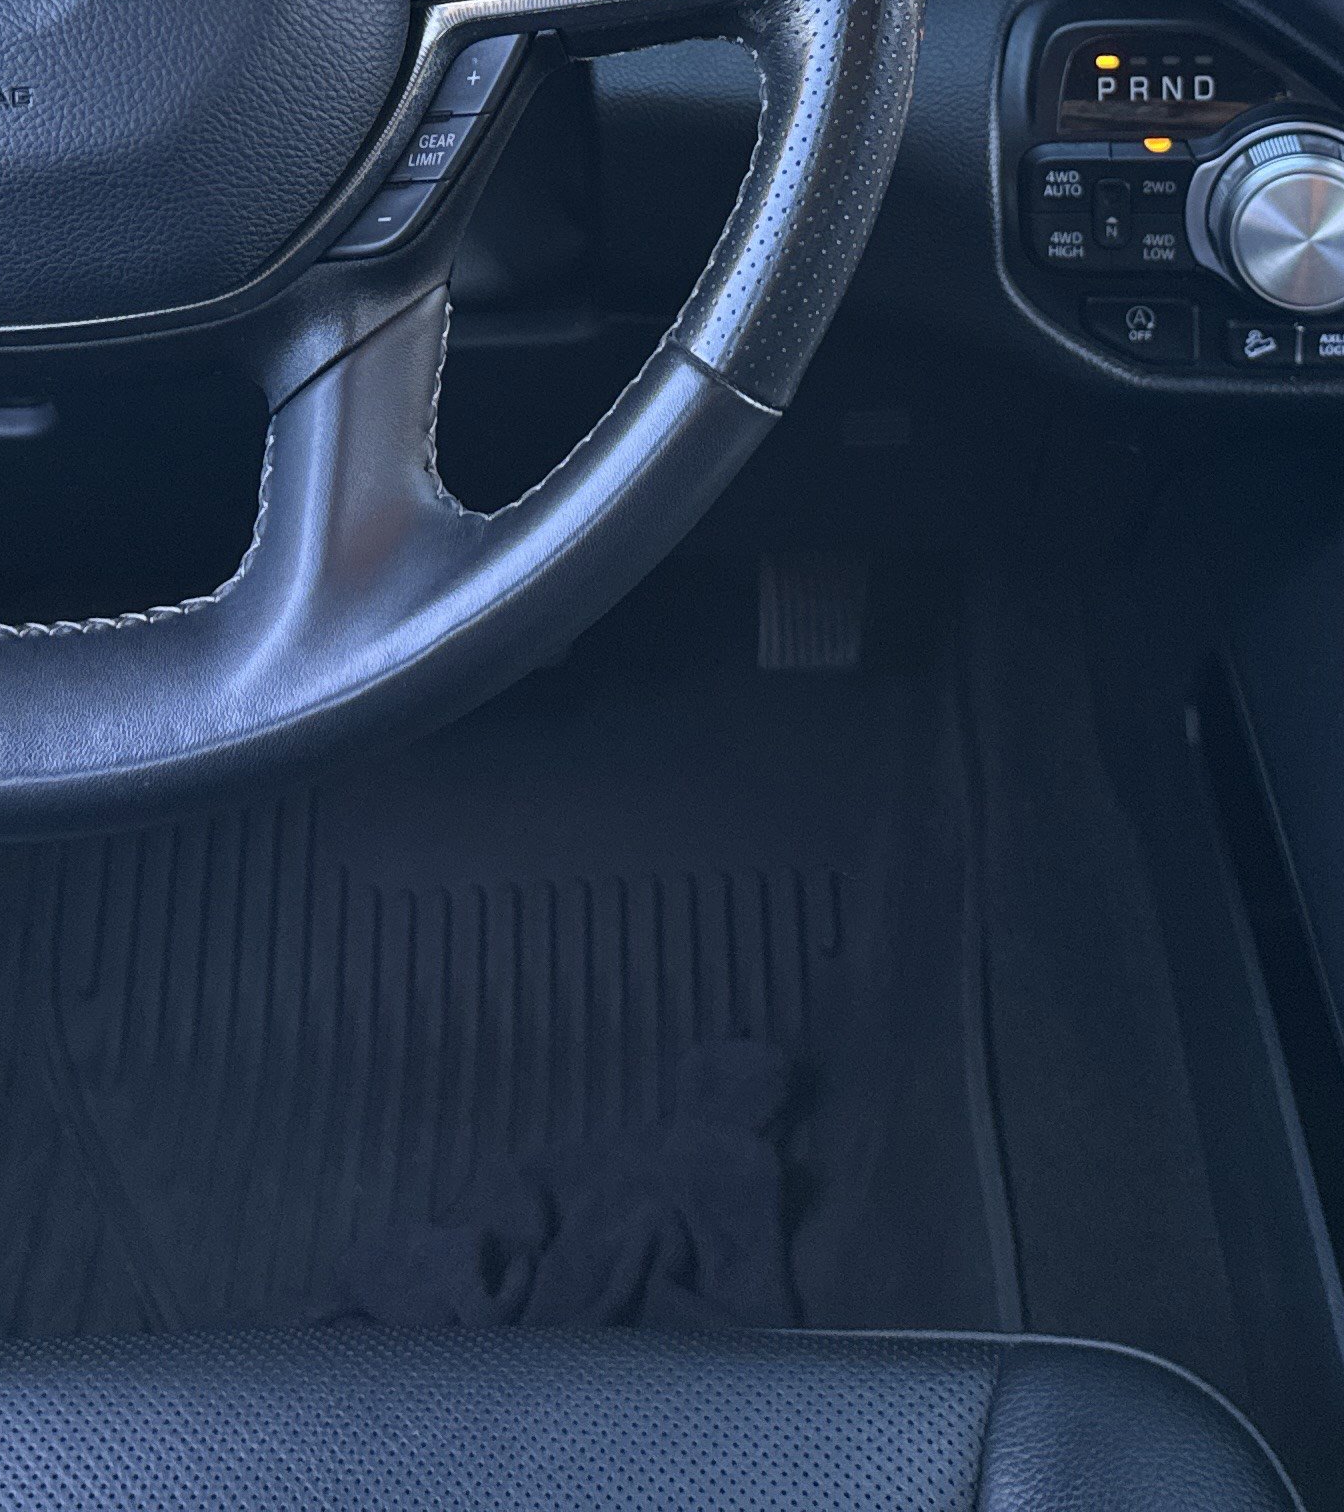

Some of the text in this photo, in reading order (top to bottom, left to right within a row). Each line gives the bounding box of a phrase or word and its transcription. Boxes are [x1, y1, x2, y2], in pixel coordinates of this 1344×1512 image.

[1097, 74, 1214, 102] P R N D
[418, 132, 456, 149] GEAR
[408, 148, 445, 167] LIMIT
[1046, 170, 1080, 183] 4WD
[1043, 184, 1083, 198] AUTO
[1142, 180, 1176, 194] 2WD
[1050, 231, 1083, 244] 4WD
[1142, 233, 1176, 246] 4WD
[1048, 245, 1084, 258] HIGH
[1143, 248, 1176, 260] LOW
[1128, 330, 1153, 341] OFF
